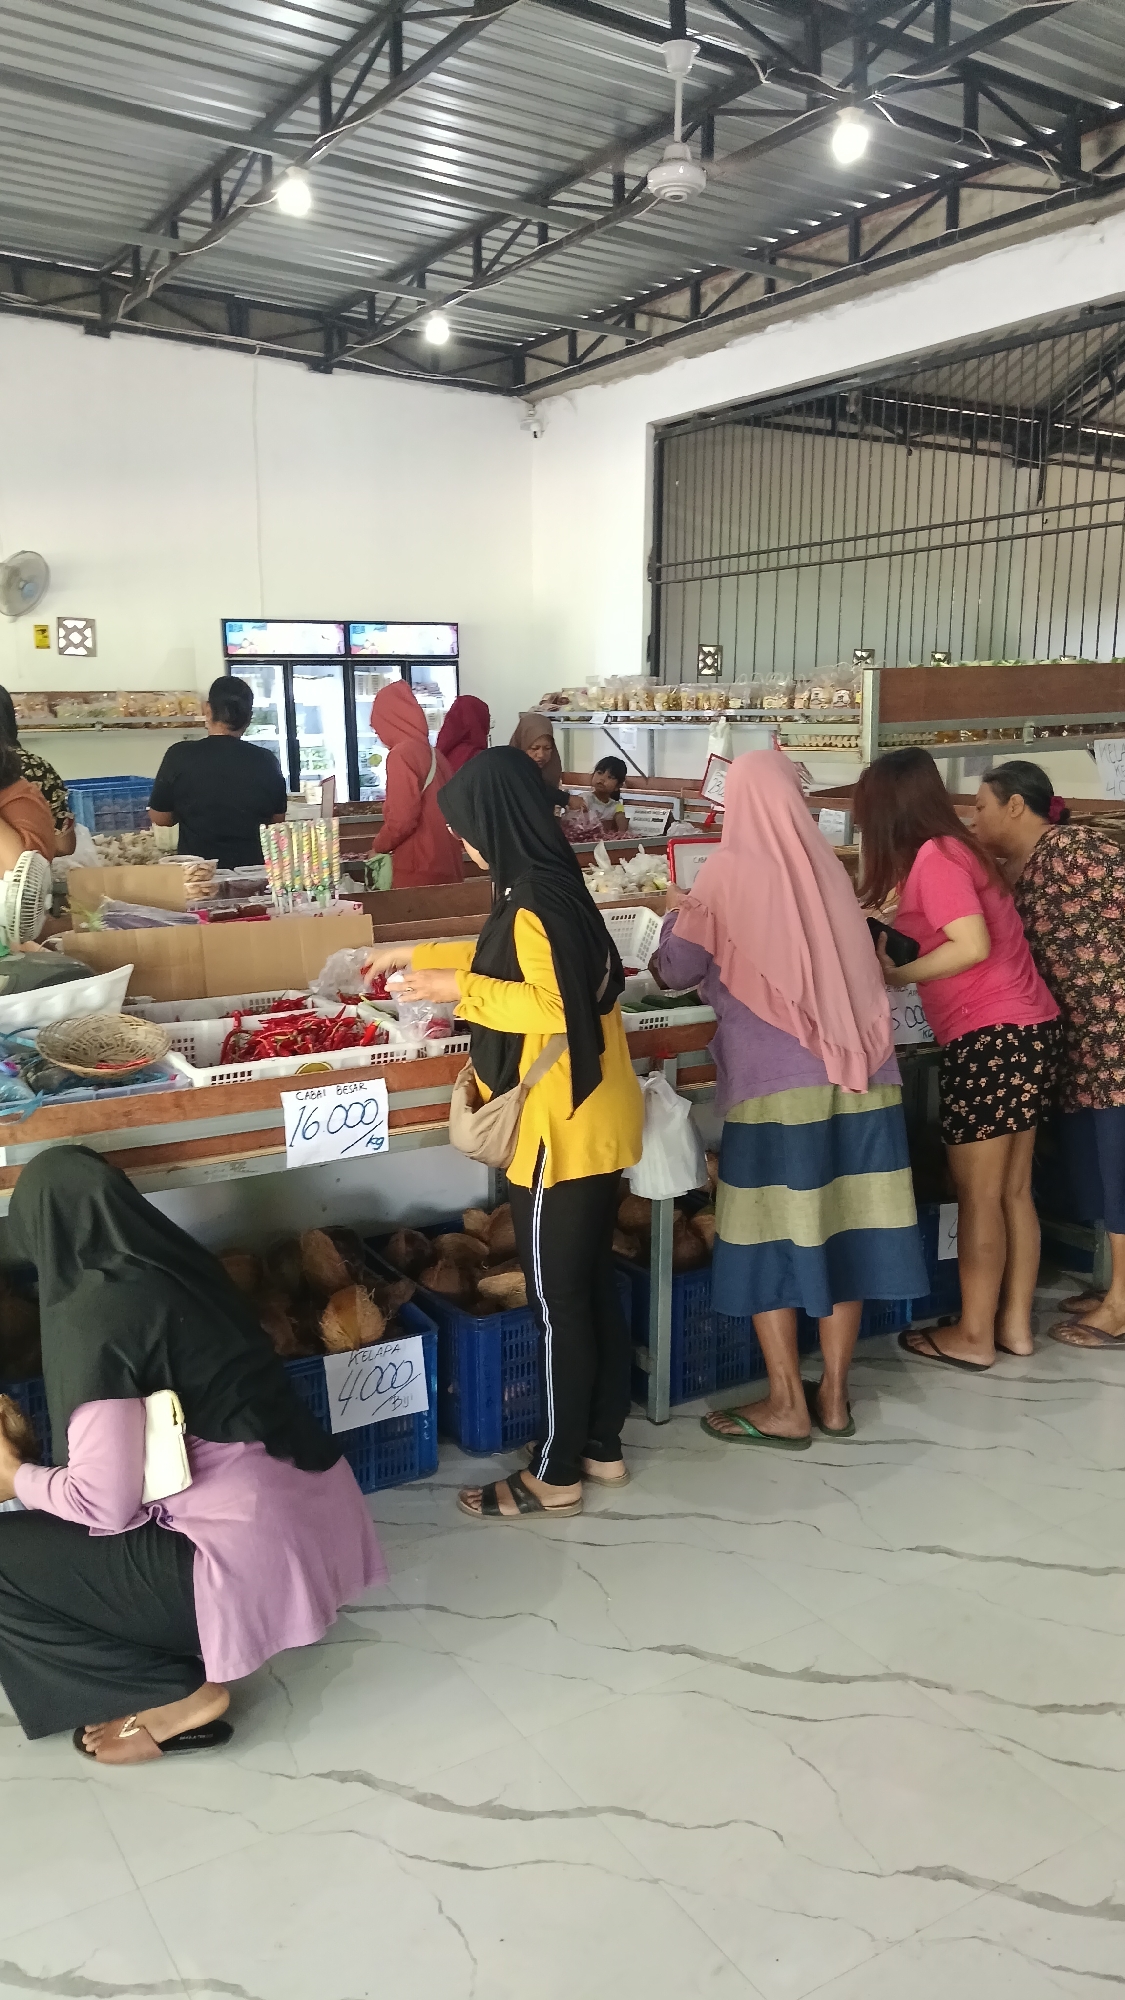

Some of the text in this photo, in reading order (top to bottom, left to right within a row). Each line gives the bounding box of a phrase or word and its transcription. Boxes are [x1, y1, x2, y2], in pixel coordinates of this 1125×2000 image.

[295, 1082, 368, 1101] CABAI BESAR
[288, 1098, 379, 1148] 16.000
[347, 1343, 402, 1368] KELAPA
[338, 1359, 414, 1416] 4.000
